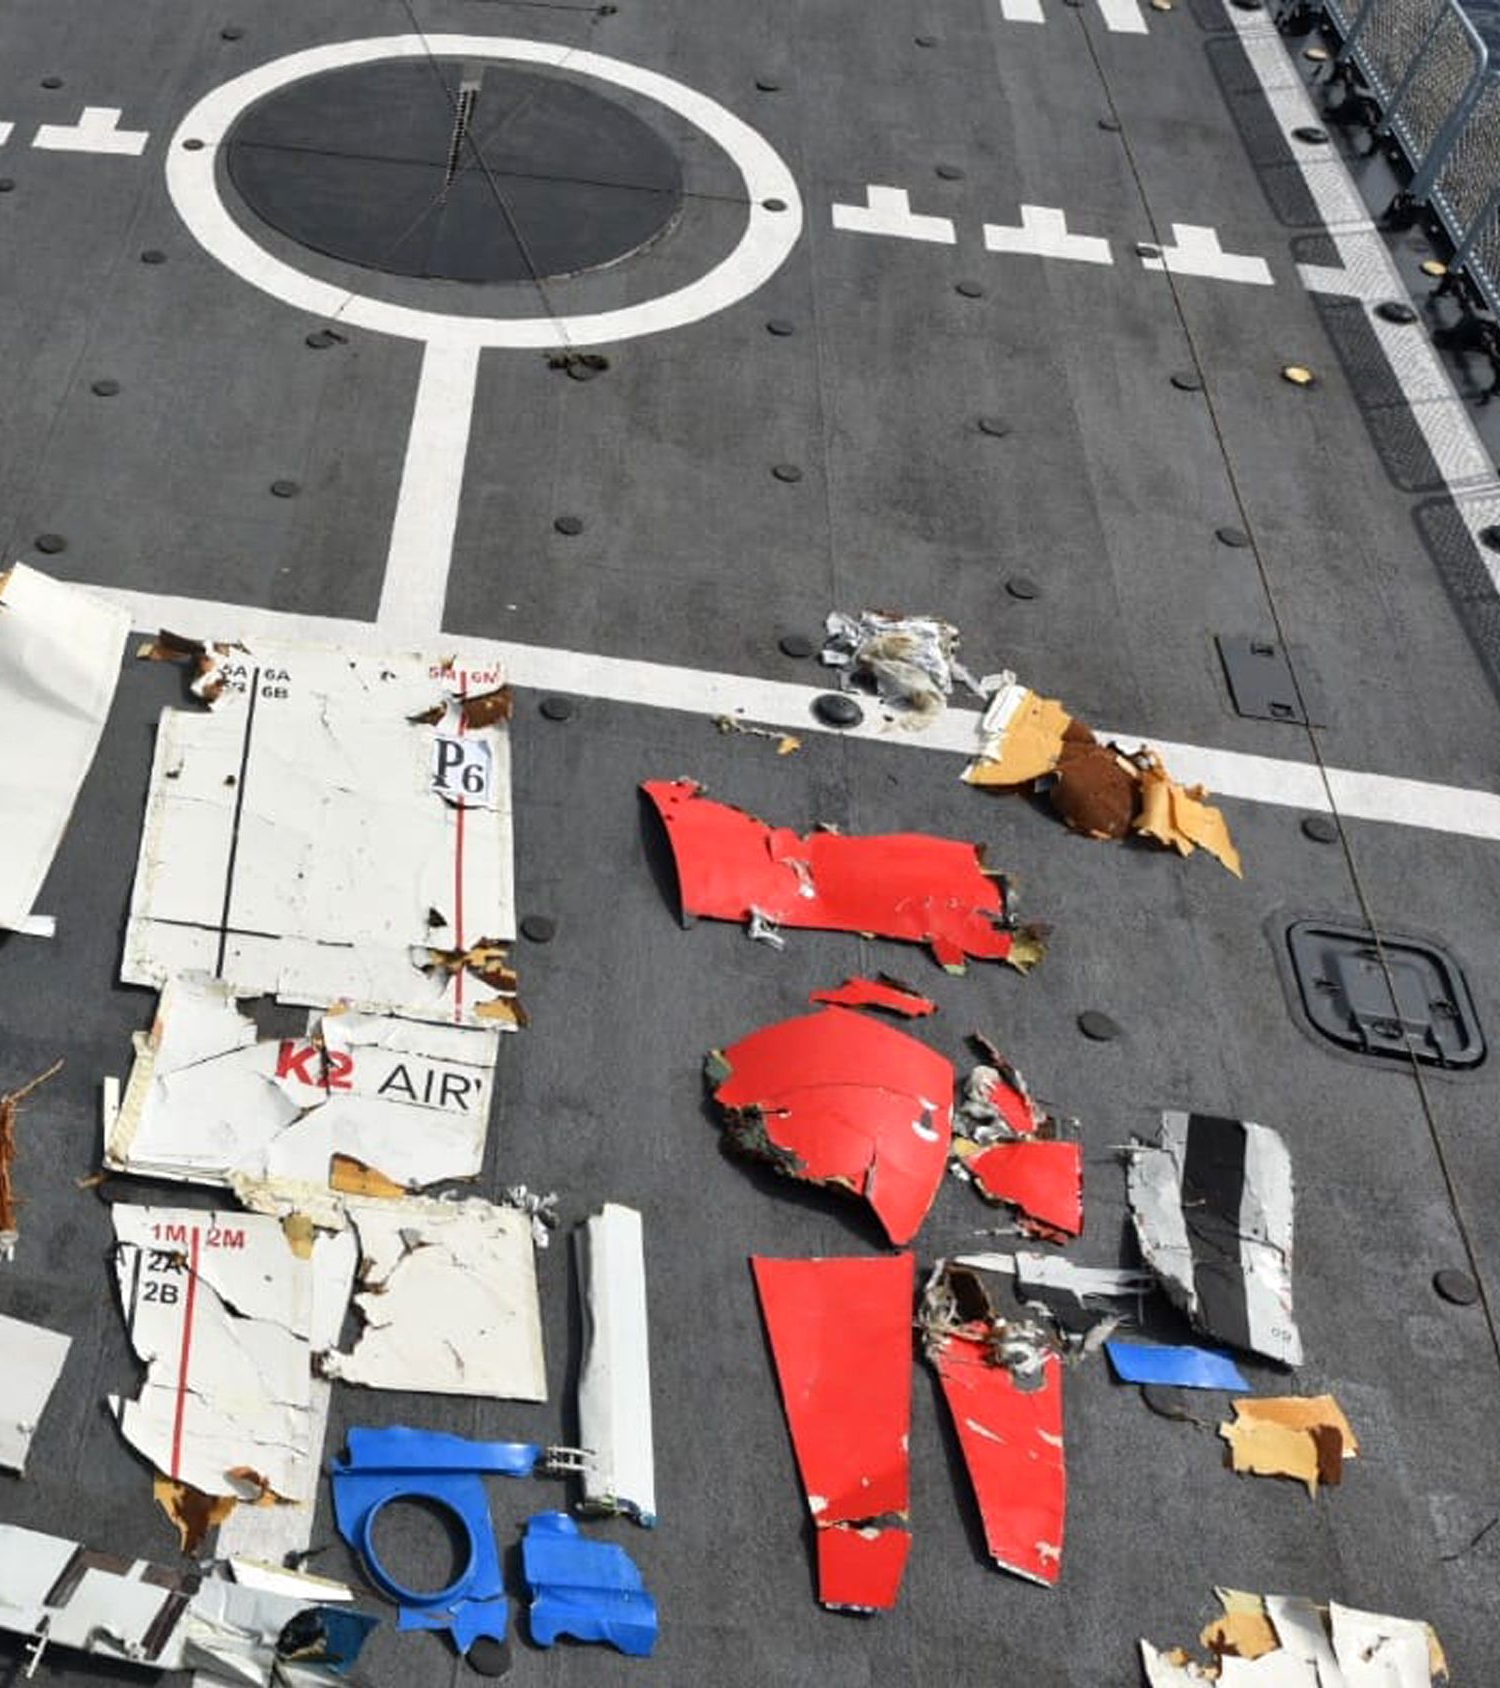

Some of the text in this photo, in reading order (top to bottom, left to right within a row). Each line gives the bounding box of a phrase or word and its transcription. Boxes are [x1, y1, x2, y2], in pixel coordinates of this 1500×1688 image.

[264, 668, 292, 682] 6A
[275, 1040, 482, 1111] K2 AIR
[151, 1223, 245, 1249] 1M 2M
[143, 1281, 179, 1304] 2B
